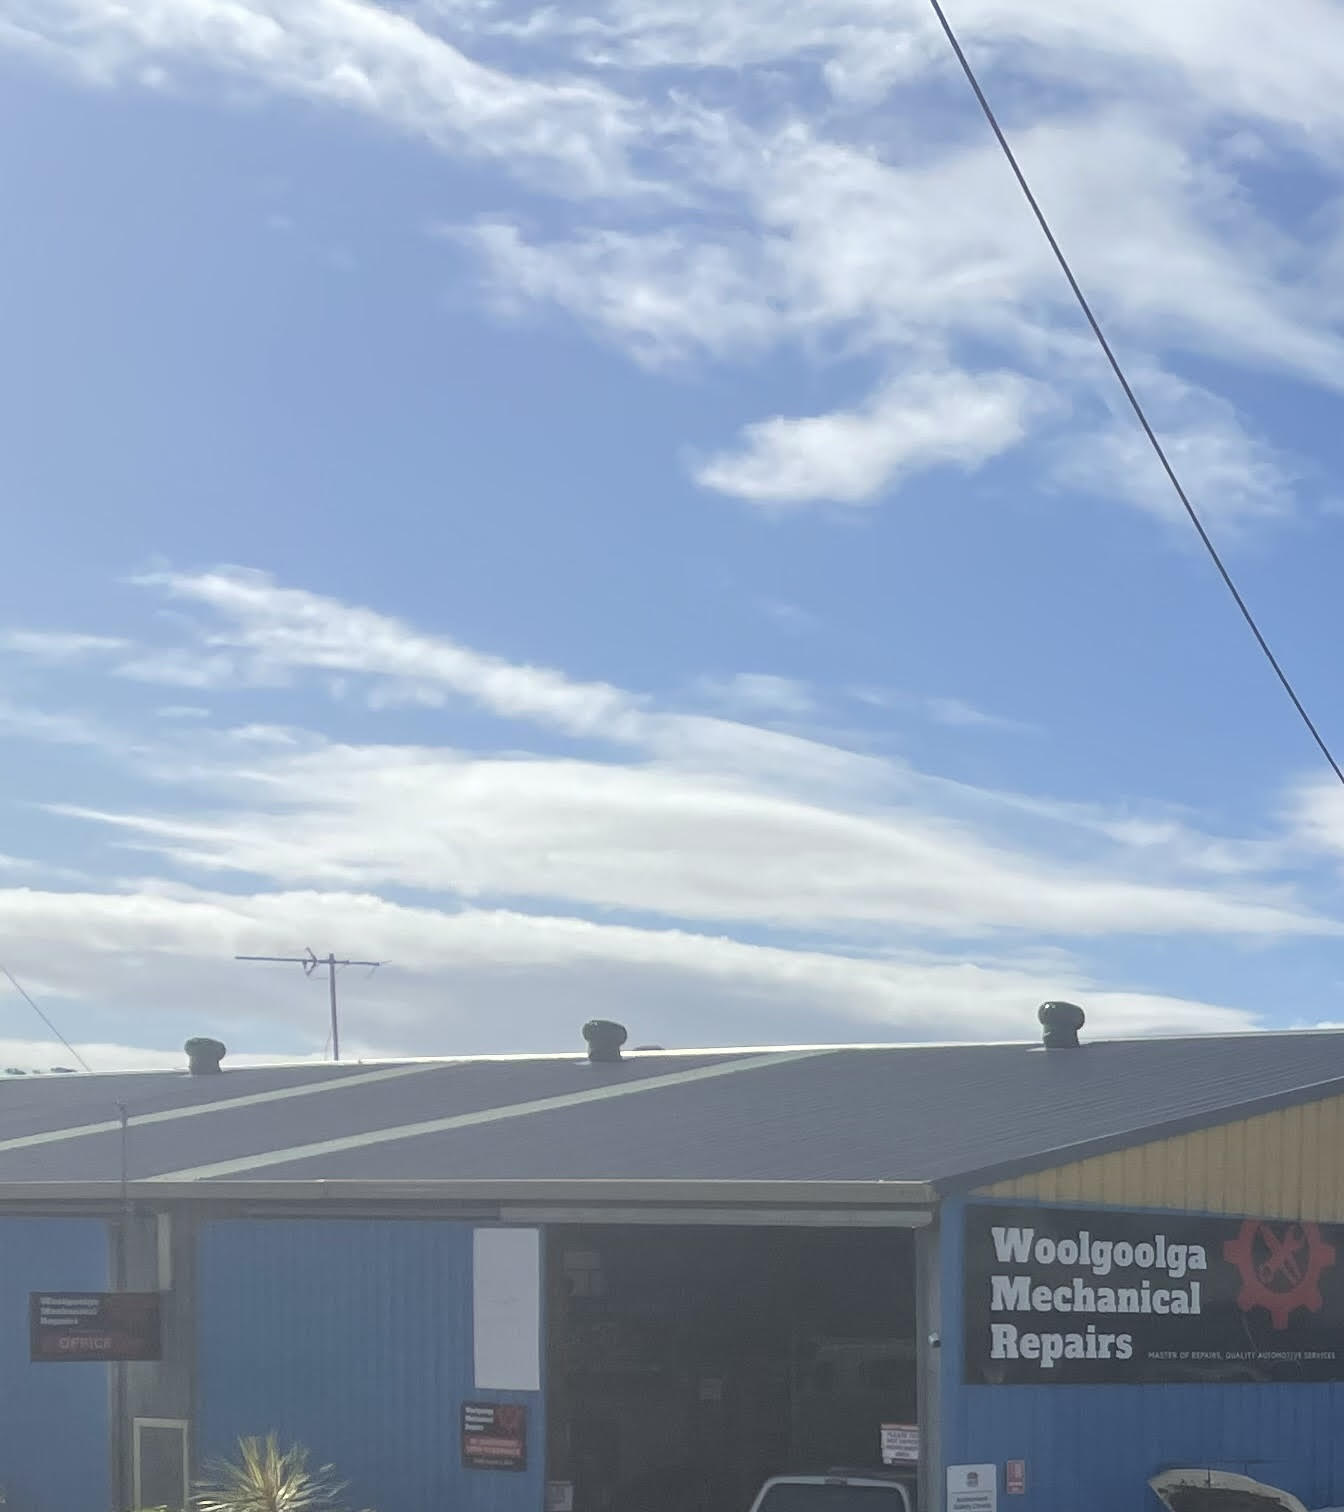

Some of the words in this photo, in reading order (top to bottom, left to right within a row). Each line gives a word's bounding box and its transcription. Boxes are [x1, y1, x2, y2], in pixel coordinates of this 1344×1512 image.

[991, 1227, 1207, 1278] Woolgoolga
[991, 1275, 1200, 1314] Mechanical
[990, 1323, 1133, 1368] Repairs
[1148, 1352, 1177, 1360] MASTER
[1225, 1352, 1255, 1360] QUALITY
[1257, 1352, 1301, 1360] AUTOMOTIVE
[1303, 1352, 1336, 1360] SERVICES
